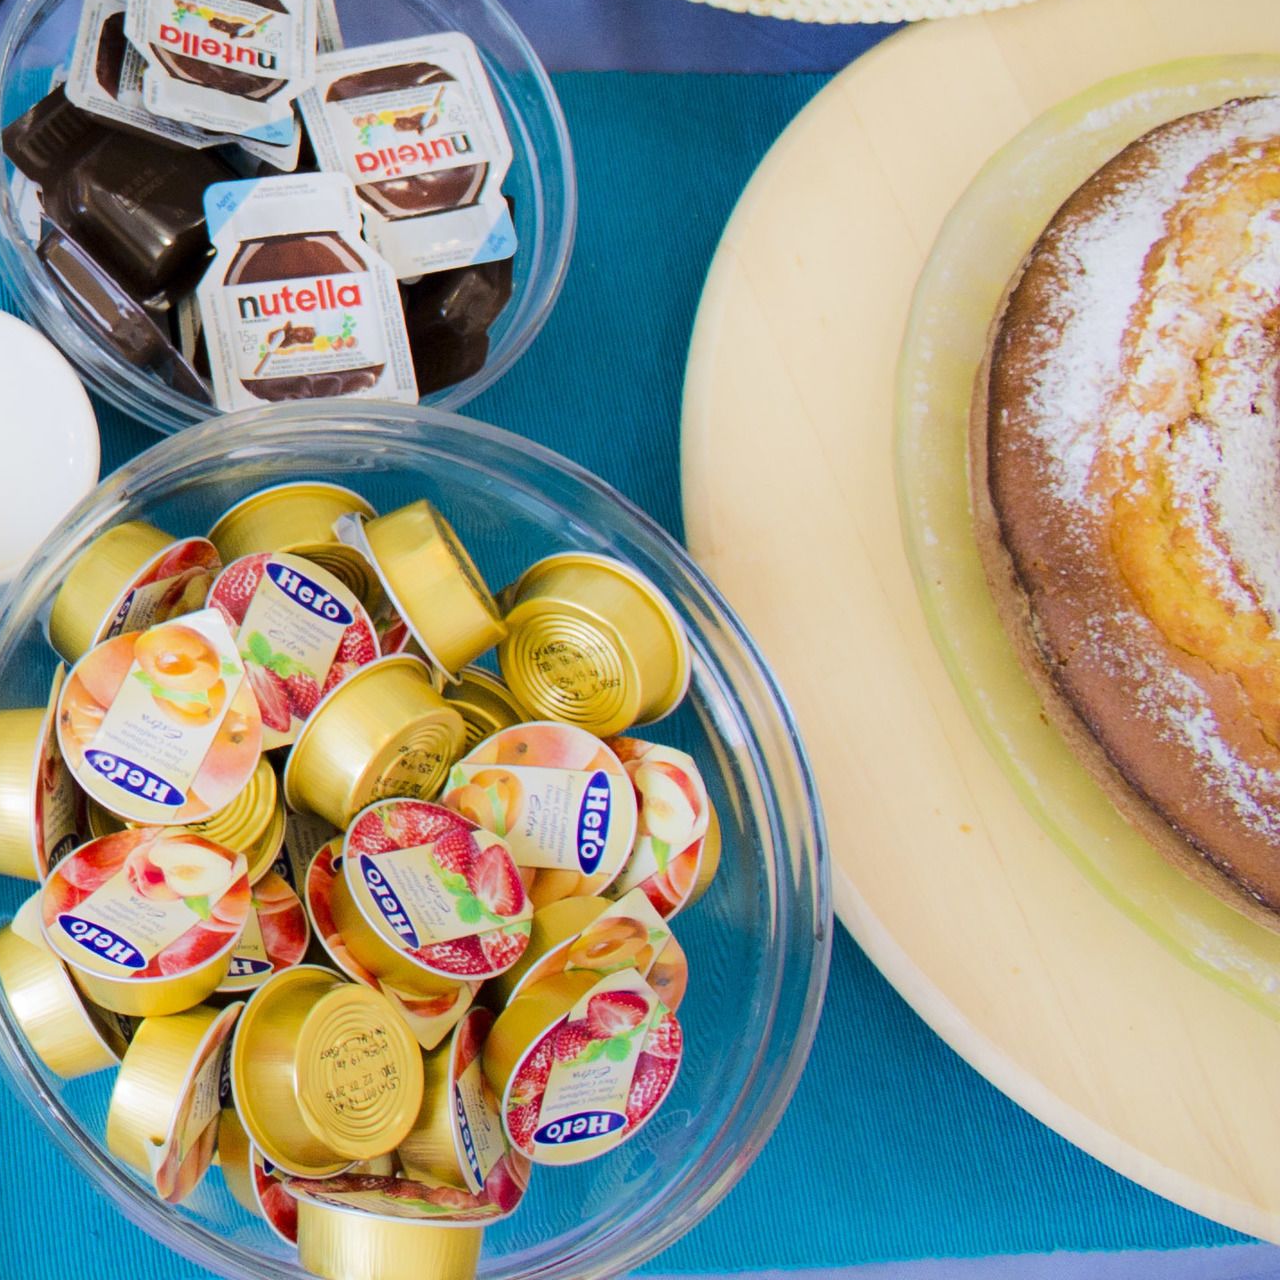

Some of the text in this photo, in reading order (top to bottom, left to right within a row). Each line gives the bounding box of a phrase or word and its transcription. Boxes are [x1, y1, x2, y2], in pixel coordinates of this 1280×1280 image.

[159, 23, 277, 72] nutella
[354, 134, 474, 178] nutella
[238, 279, 363, 321] nutella
[275, 566, 342, 620] Hero
[94, 755, 172, 803] Hero
[524, 794, 543, 836] Extra
[579, 785, 609, 858] Hero
[366, 866, 413, 936] Hero
[69, 917, 136, 964] Hero
[546, 1114, 611, 1142] Hero
